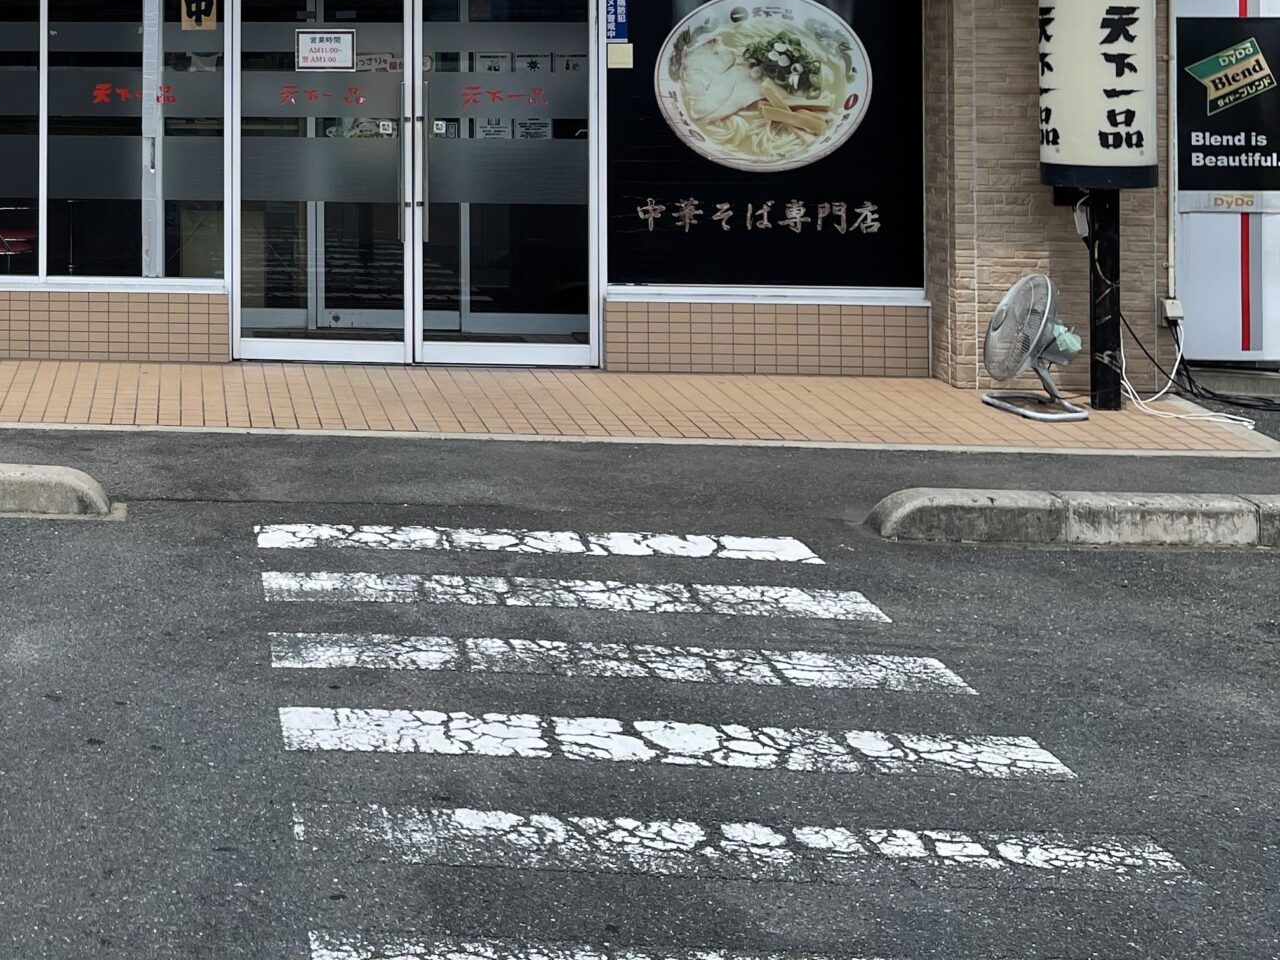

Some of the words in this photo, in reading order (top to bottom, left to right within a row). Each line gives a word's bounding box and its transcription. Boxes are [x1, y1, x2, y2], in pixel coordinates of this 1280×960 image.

[1218, 42, 1254, 66] DyDo
[1098, 6, 1145, 149] 天下一品
[1211, 58, 1265, 92] Blend
[280, 84, 365, 105] 天下一品
[462, 85, 549, 106] 天下一品
[1191, 131, 1245, 146] Blend
[1251, 131, 1267, 146] is
[1213, 192, 1255, 209] DyDo
[637, 197, 881, 234] 中華そば専門店
